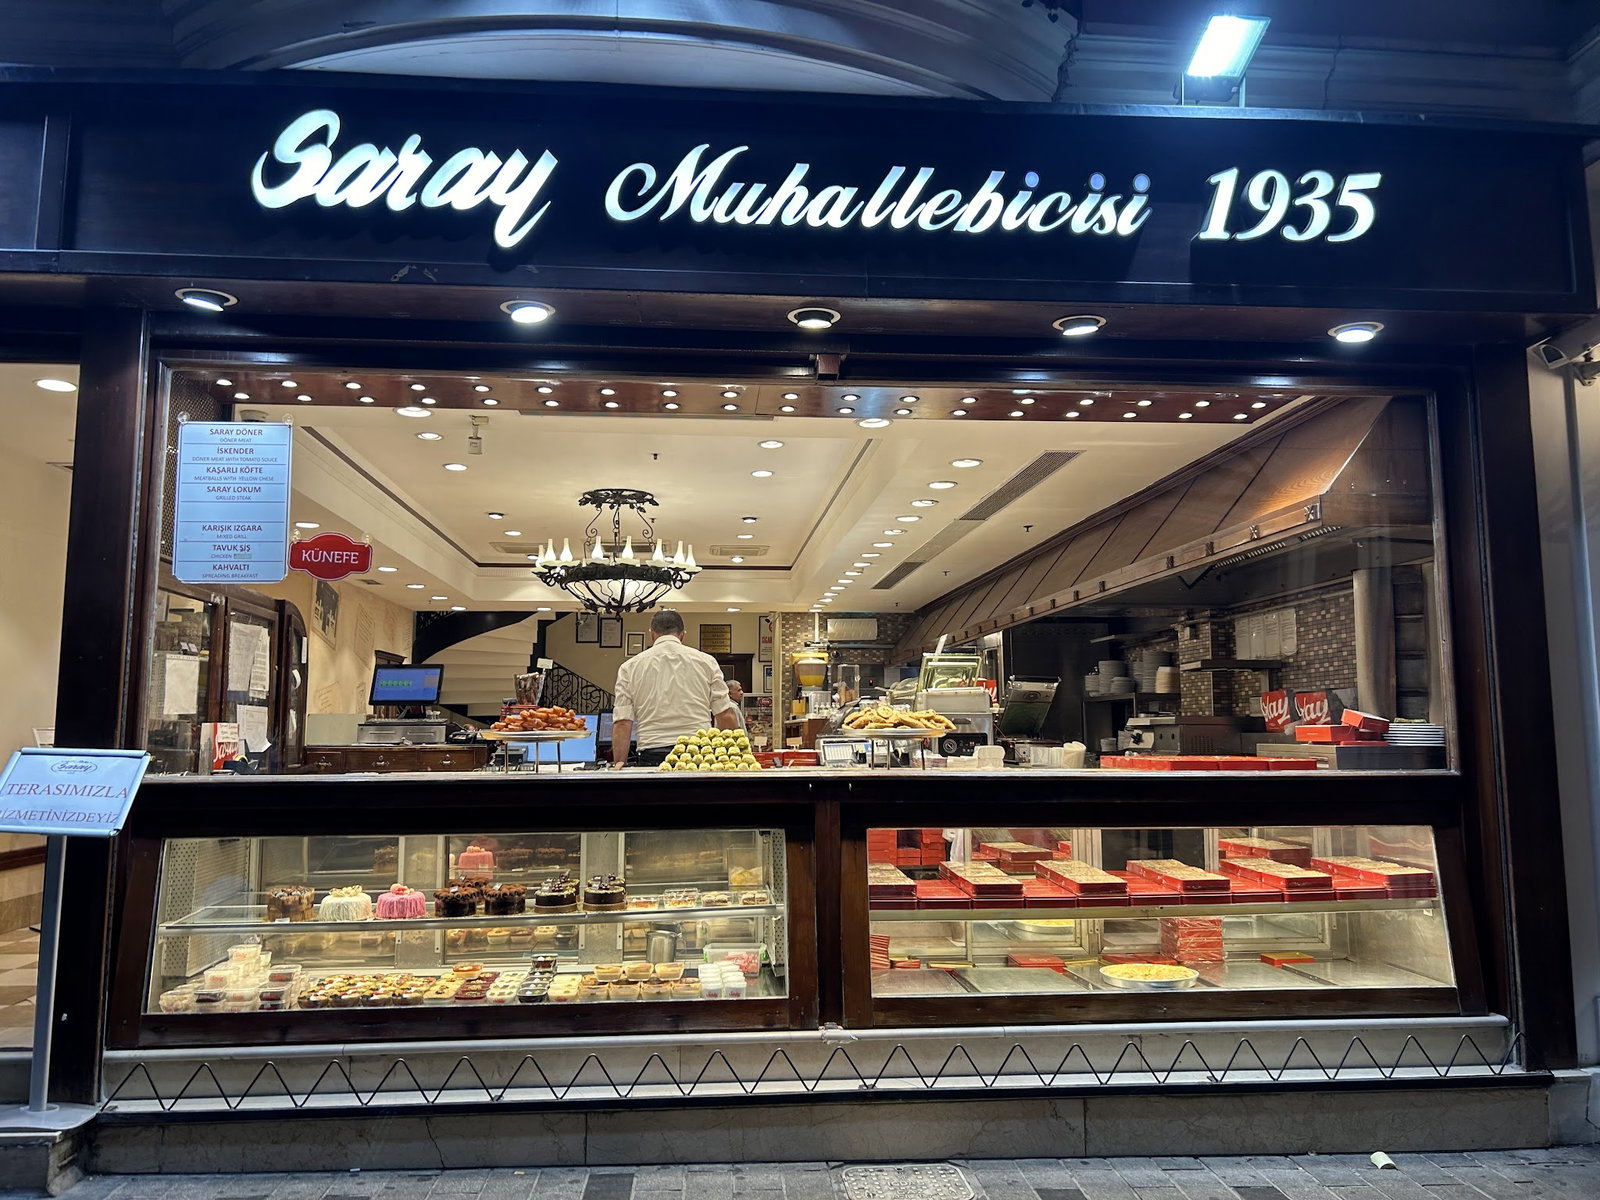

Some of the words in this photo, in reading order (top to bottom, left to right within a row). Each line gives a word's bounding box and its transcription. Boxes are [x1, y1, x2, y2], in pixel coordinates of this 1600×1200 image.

[251, 109, 559, 248] Saray
[605, 143, 1152, 237] Muhallebicisi
[1198, 166, 1382, 243] 1935
[236, 428, 263, 436] DÖNER
[206, 466, 238, 474] KAŞARLI
[240, 465, 263, 474] KÖFTE
[202, 524, 232, 533] KARIŞIK
[233, 524, 263, 532] IZGARA
[212, 544, 239, 552] TAVUK
[239, 544, 251, 553] ŞİŞ
[301, 548, 360, 565] KÜNEFE
[7, 783, 128, 798] TERASIMIZLA
